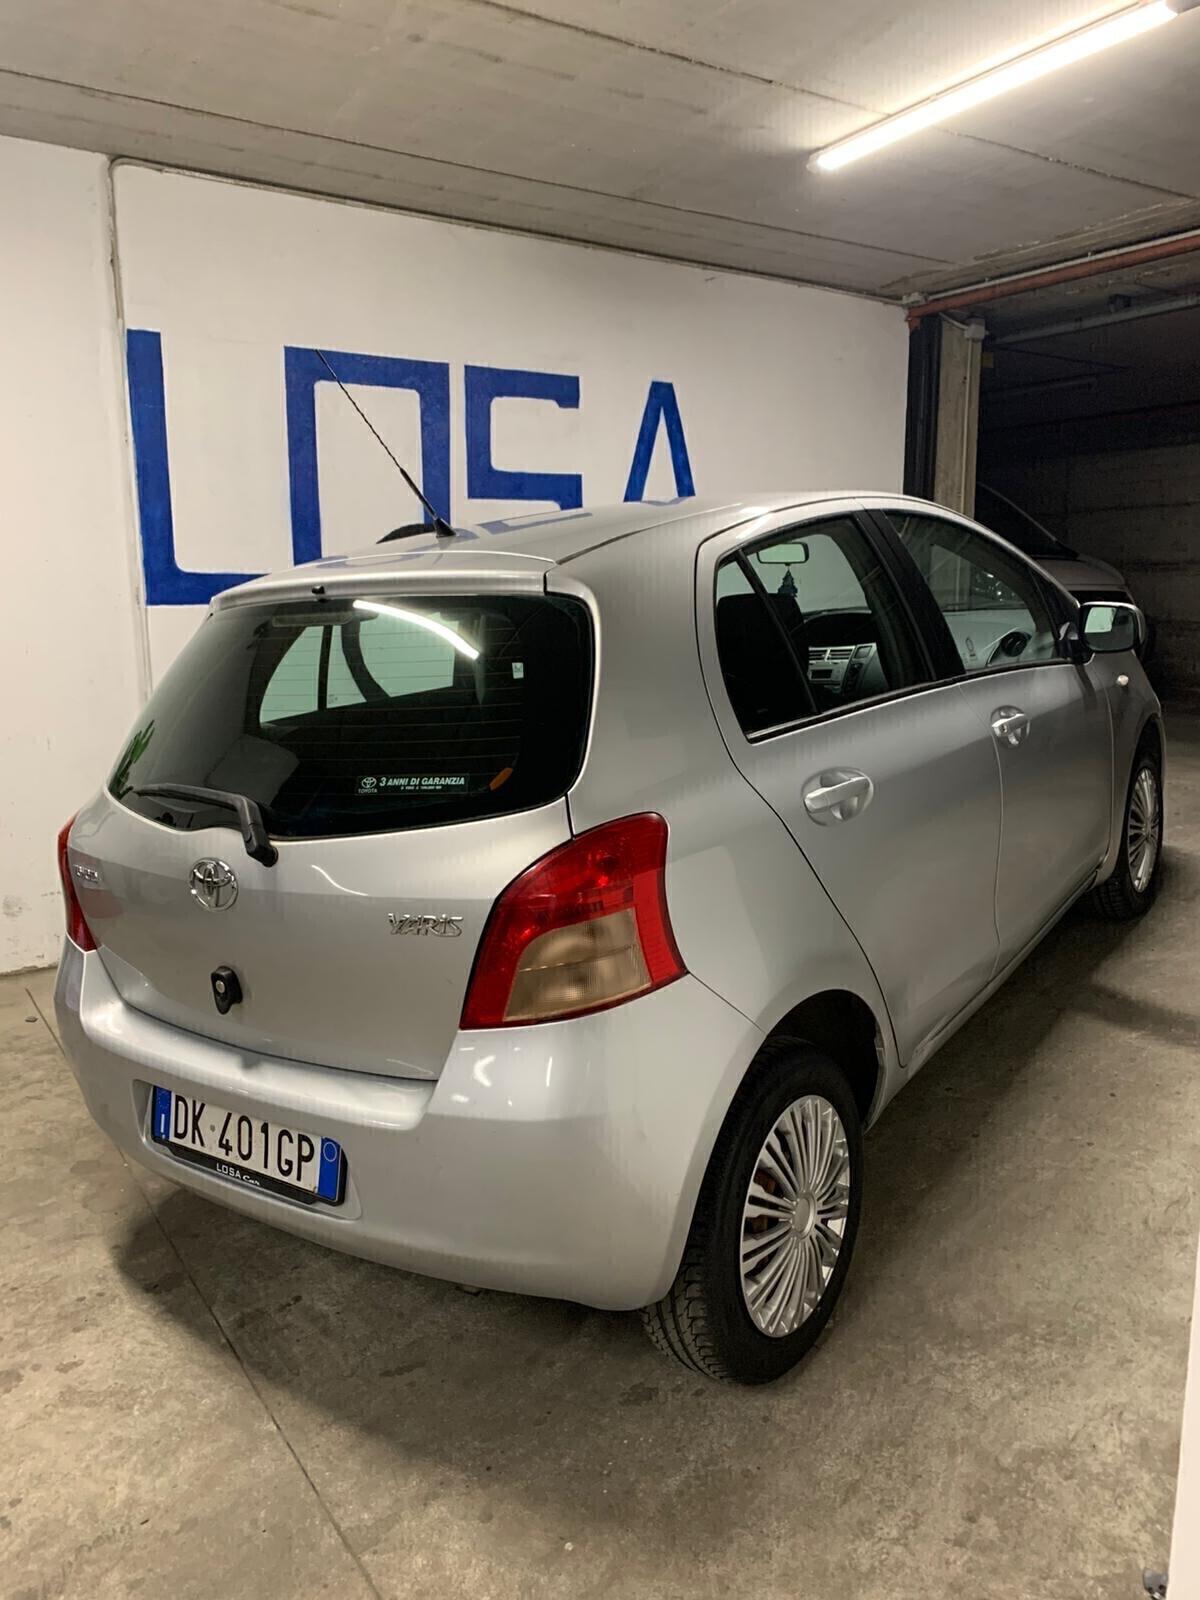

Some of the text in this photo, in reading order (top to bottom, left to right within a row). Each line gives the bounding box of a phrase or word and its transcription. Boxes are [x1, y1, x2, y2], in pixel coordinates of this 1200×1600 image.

[379, 777, 386, 786] 3
[387, 778, 409, 786] ANNI
[421, 777, 465, 785] GARANZIA
[173, 1094, 315, 1182] DK 401GP
[216, 1162, 241, 1179] LOSA
